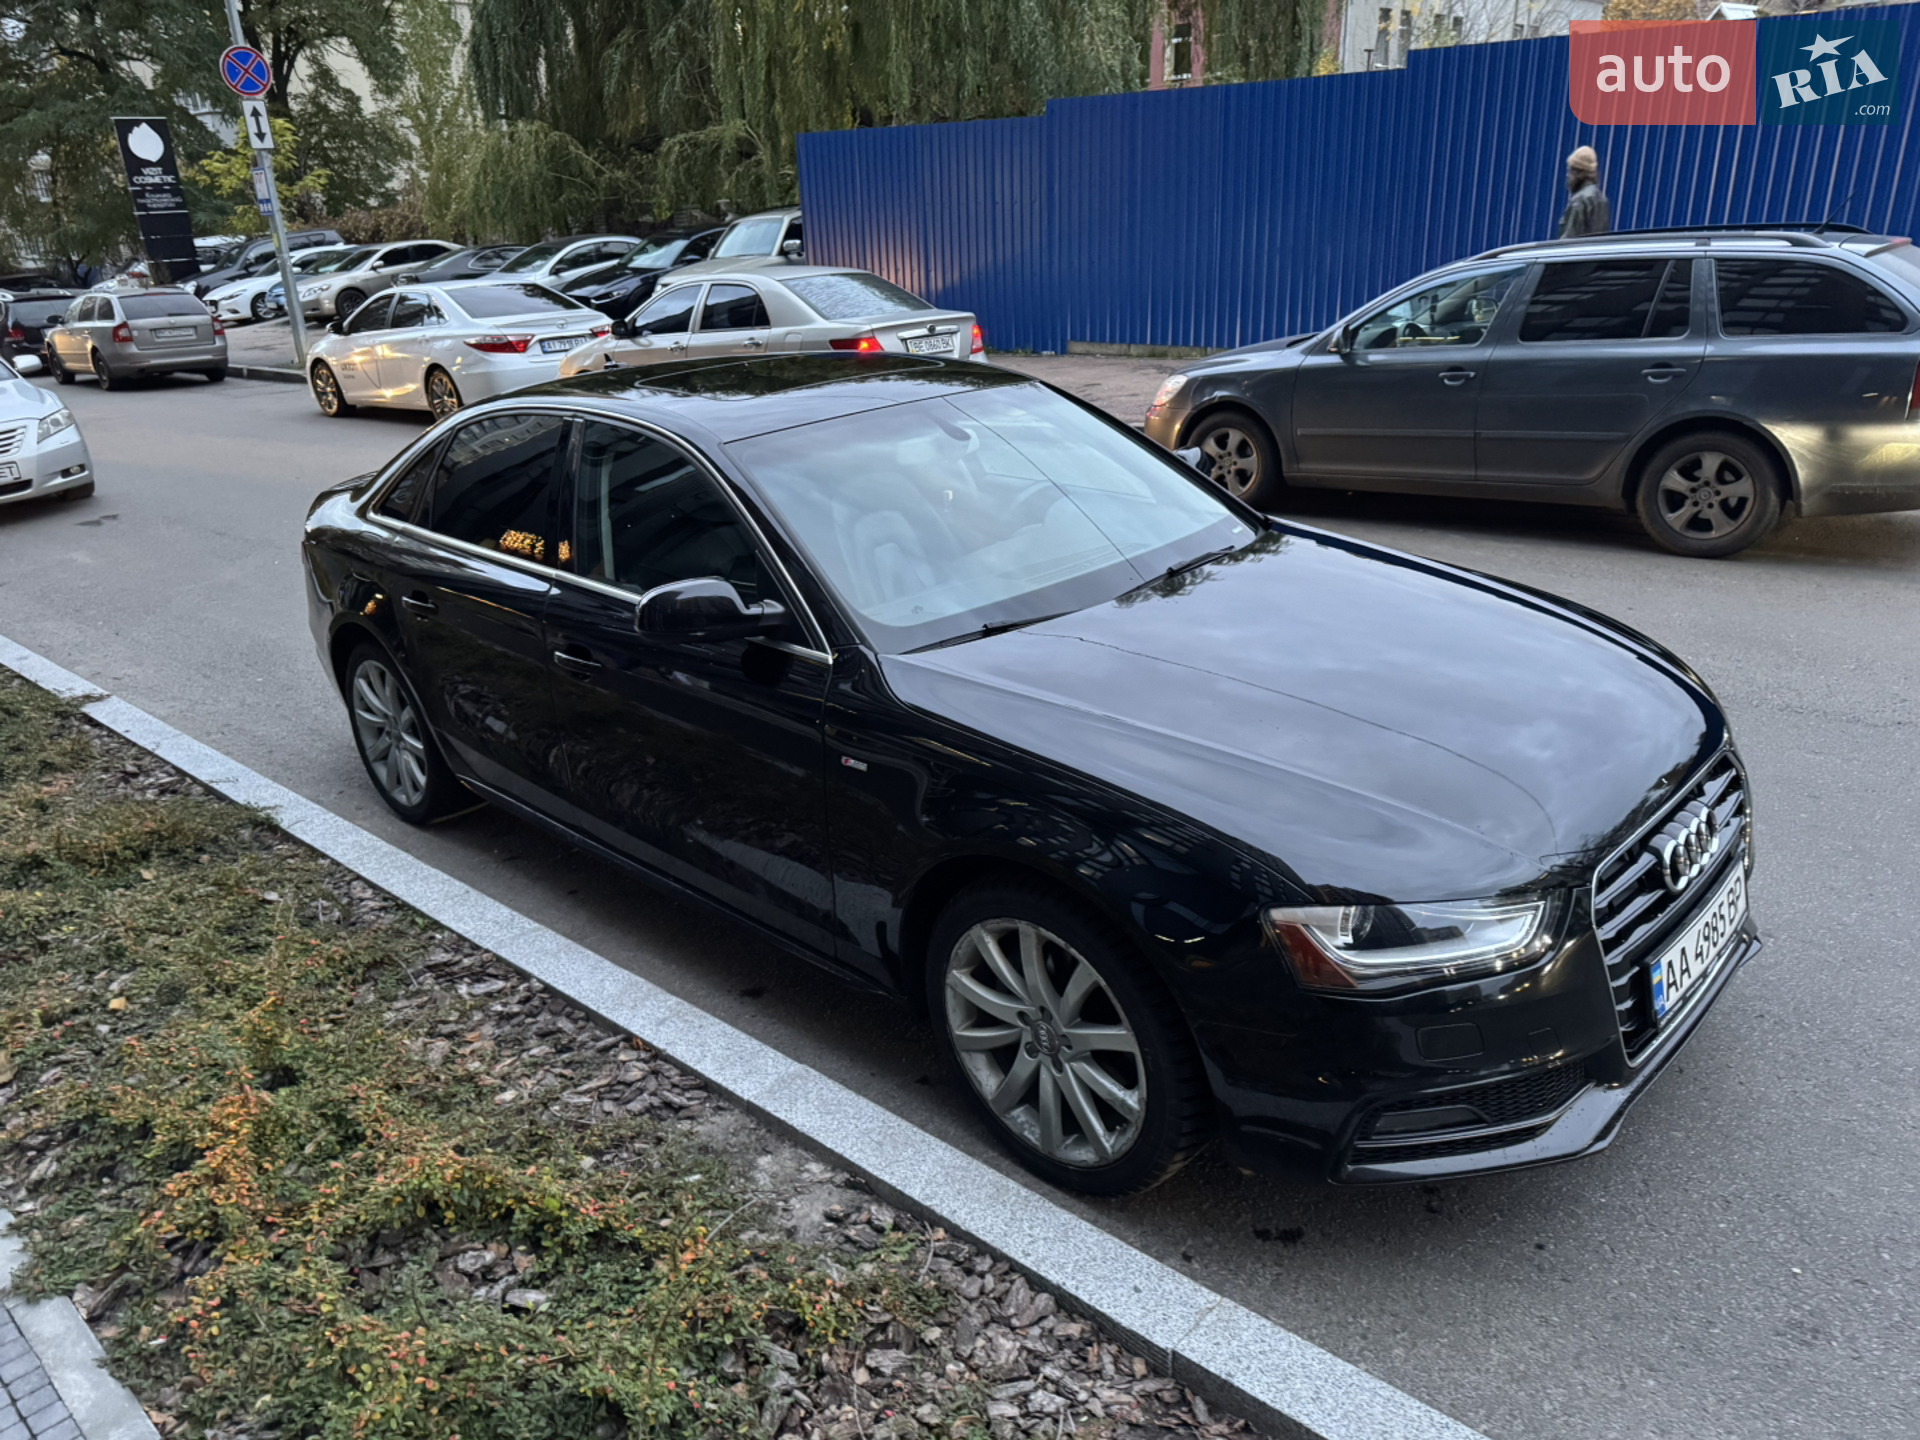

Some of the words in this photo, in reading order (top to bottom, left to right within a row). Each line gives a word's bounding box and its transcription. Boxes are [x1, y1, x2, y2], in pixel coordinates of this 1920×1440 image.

[132, 175, 177, 184] COSMETIC
[1666, 945, 1692, 1003] AA
[1694, 901, 1726, 966] 4985
[1726, 876, 1742, 927] BP
